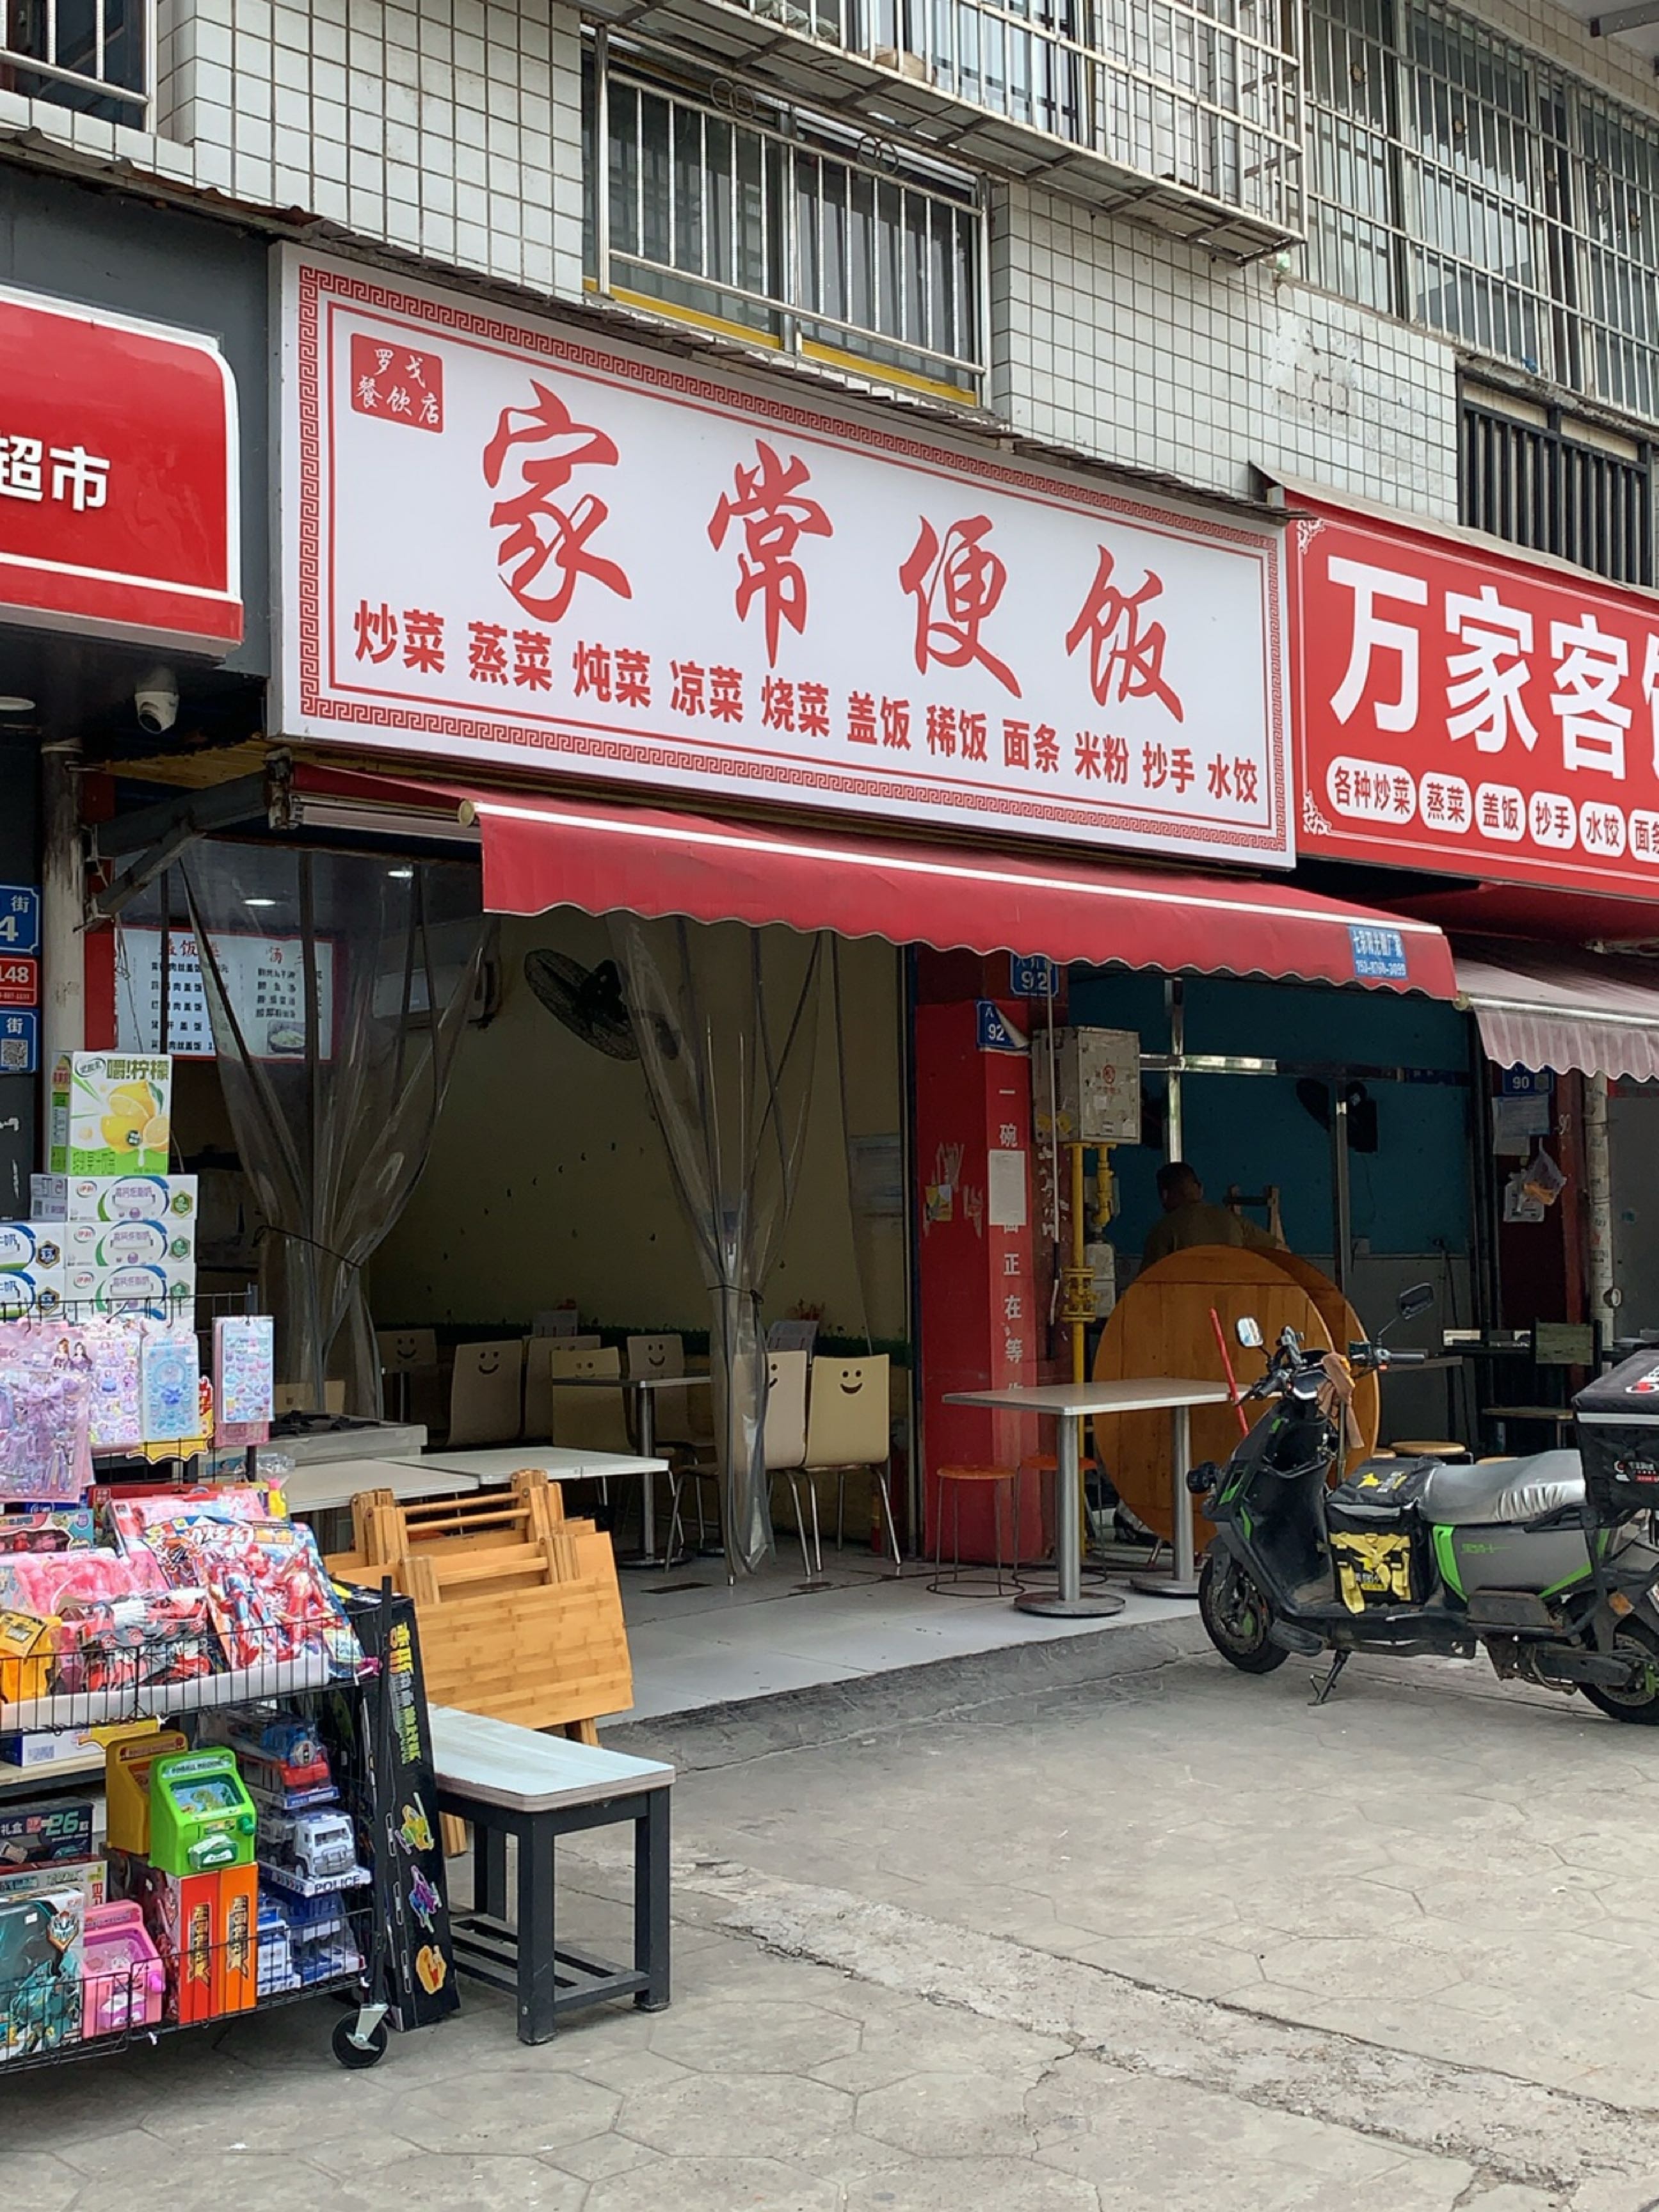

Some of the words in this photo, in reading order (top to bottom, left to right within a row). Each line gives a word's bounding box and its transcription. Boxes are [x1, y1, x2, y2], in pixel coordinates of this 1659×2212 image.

[355, 374, 439, 424] 餐饮店
[0, 435, 110, 511] 超市
[483, 379, 1183, 723] 家常便饭
[354, 600, 445, 674] 炒菜
[467, 621, 552, 691] 蒸菜
[572, 641, 651, 707] 炖菜
[669, 660, 743, 722] 凉菜
[760, 676, 830, 737] 烧菜
[847, 692, 911, 750] 盖饭
[926, 705, 988, 762] 稀饭
[1002, 718, 1060, 773] 面条
[1074, 732, 1130, 785] 米粉
[1142, 743, 1195, 794] 抄手
[1207, 754, 1258, 803] 水饺
[1334, 765, 1411, 815] 各种炒菜
[1427, 783, 1465, 823] 蒸菜
[1482, 792, 1519, 831] 盖饭
[1535, 801, 1571, 838] 抄手
[1586, 811, 1619, 847] 水饺
[11, 895, 29, 913] 街
[1020, 972, 1048, 991] 92
[6, 1017, 23, 1034] 街
[988, 1023, 1006, 1041] 92
[1512, 1076, 1530, 1089] 90
[314, 1875, 360, 1890] POLICE
